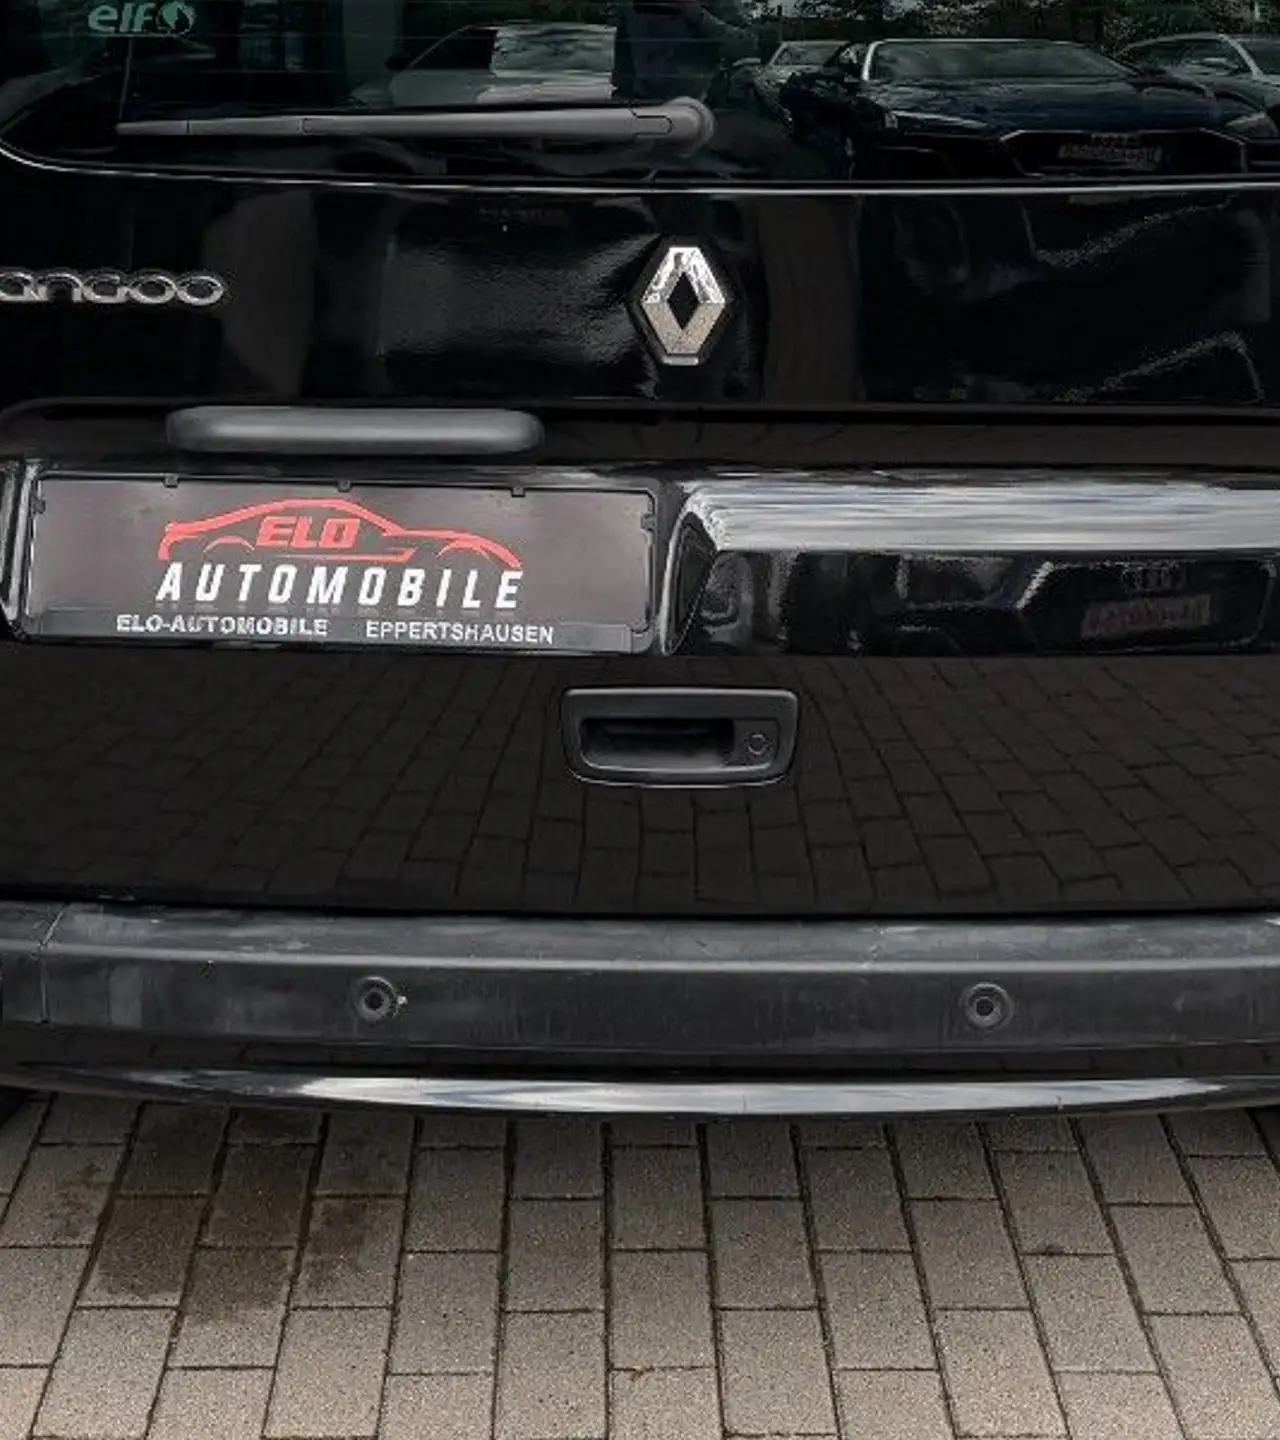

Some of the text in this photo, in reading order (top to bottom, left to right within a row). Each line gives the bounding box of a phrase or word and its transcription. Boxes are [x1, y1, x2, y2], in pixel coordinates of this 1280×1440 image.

[87, 2, 157, 33] elf
[256, 515, 361, 550] ELO
[155, 561, 524, 610] AUTOMOBILE
[116, 614, 556, 645] ELO-AUTOMOBILE EPPERTSHAUSEN
